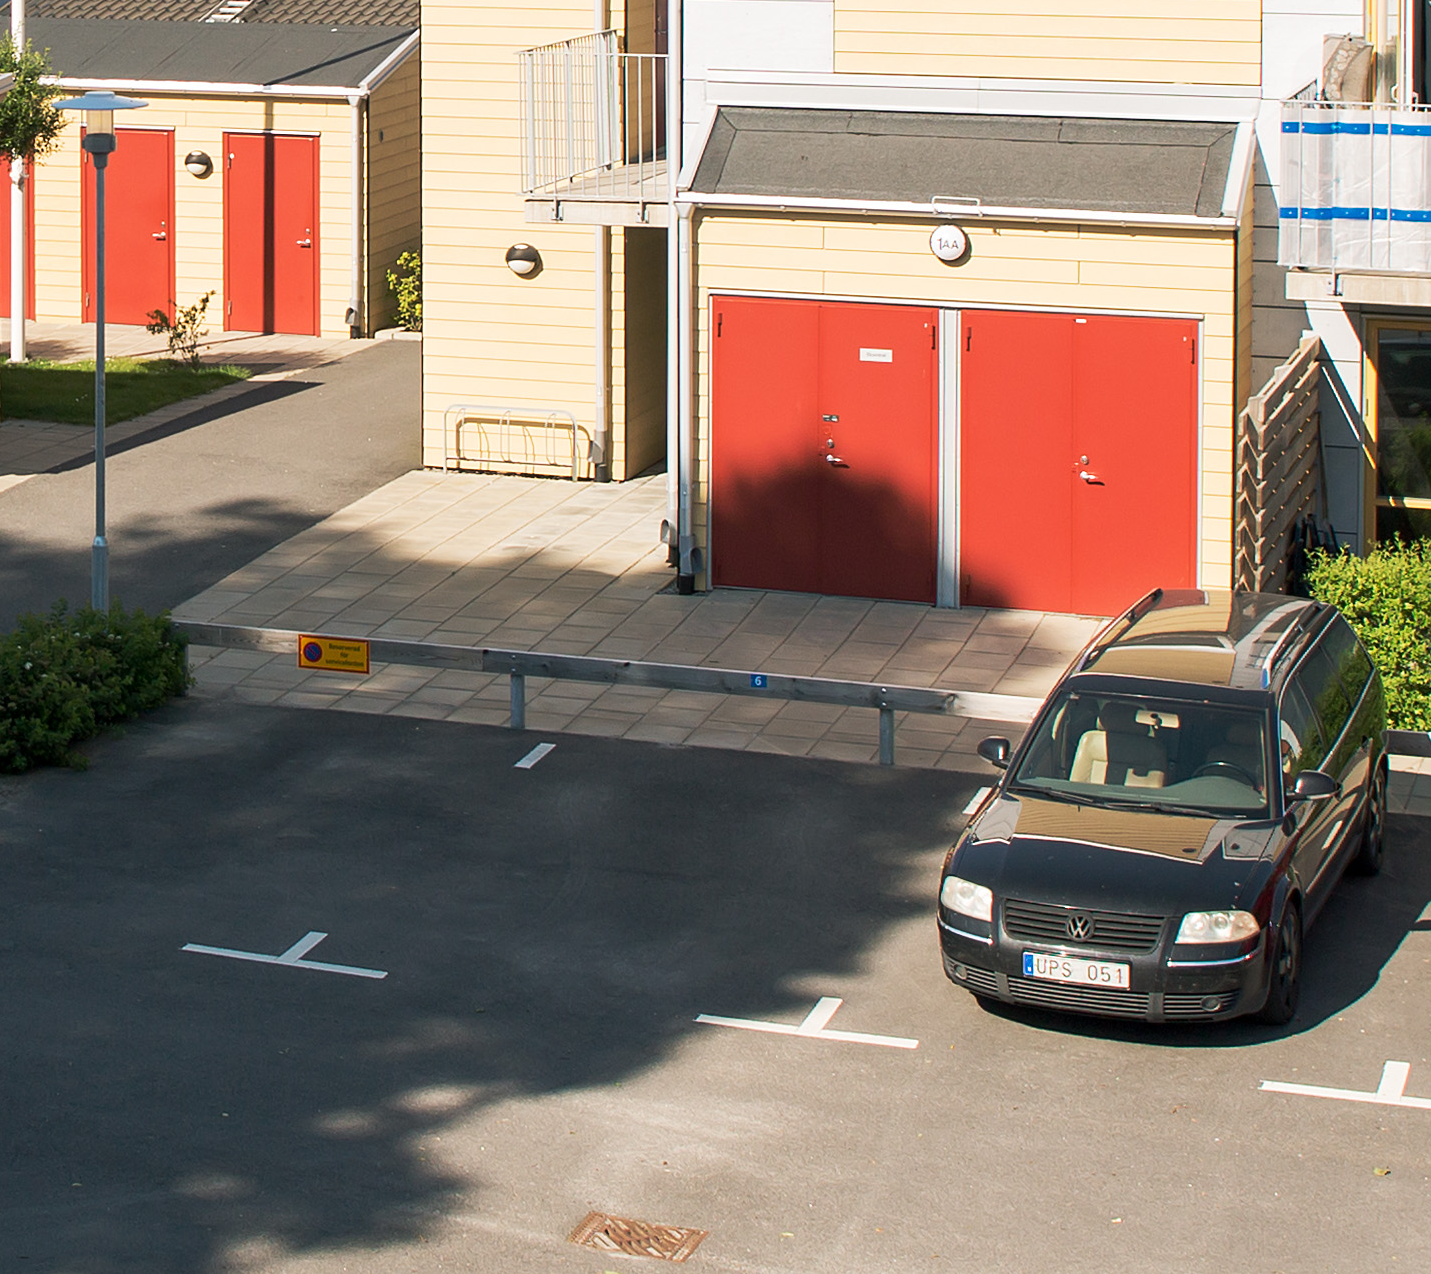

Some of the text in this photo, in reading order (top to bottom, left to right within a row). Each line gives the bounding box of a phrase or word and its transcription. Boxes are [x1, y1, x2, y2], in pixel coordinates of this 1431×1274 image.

[937, 237, 959, 250] 1AA
[754, 675, 762, 686] 6
[1036, 958, 1123, 984] UPS 051
